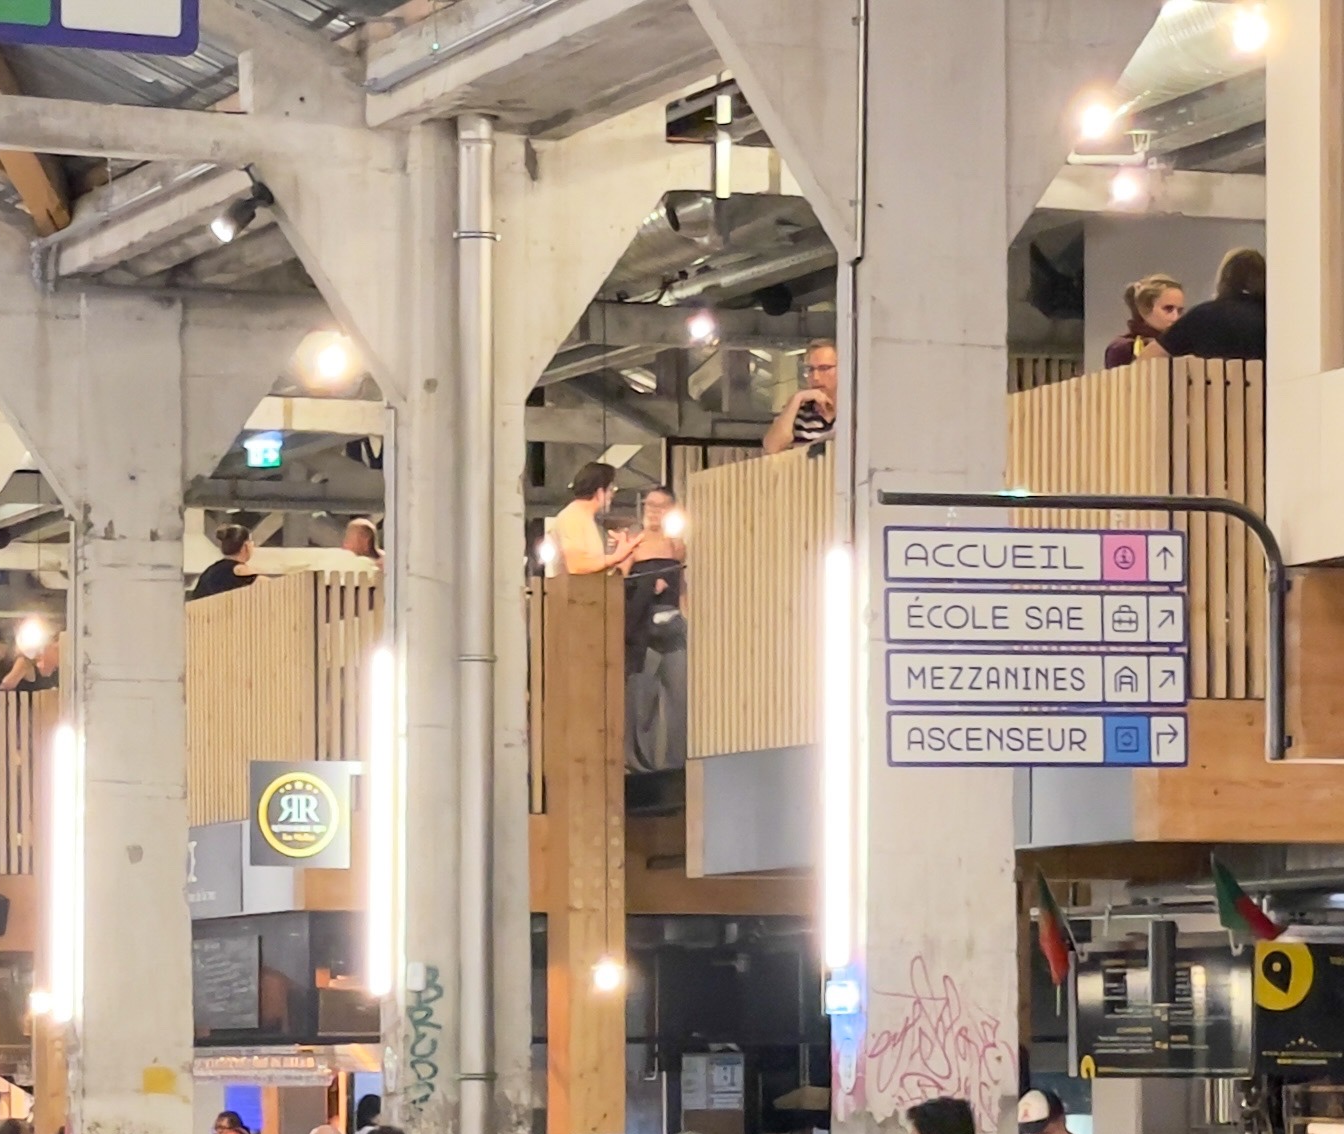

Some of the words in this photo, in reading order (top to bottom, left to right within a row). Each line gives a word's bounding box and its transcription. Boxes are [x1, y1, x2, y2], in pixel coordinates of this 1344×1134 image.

[904, 542, 1084, 570] ACCUEIL
[906, 595, 1010, 631] ÉCOLE
[1024, 605, 1085, 631] SAE
[906, 665, 1087, 692] MEZZANINES
[906, 726, 1088, 752] ASCENSEUR
